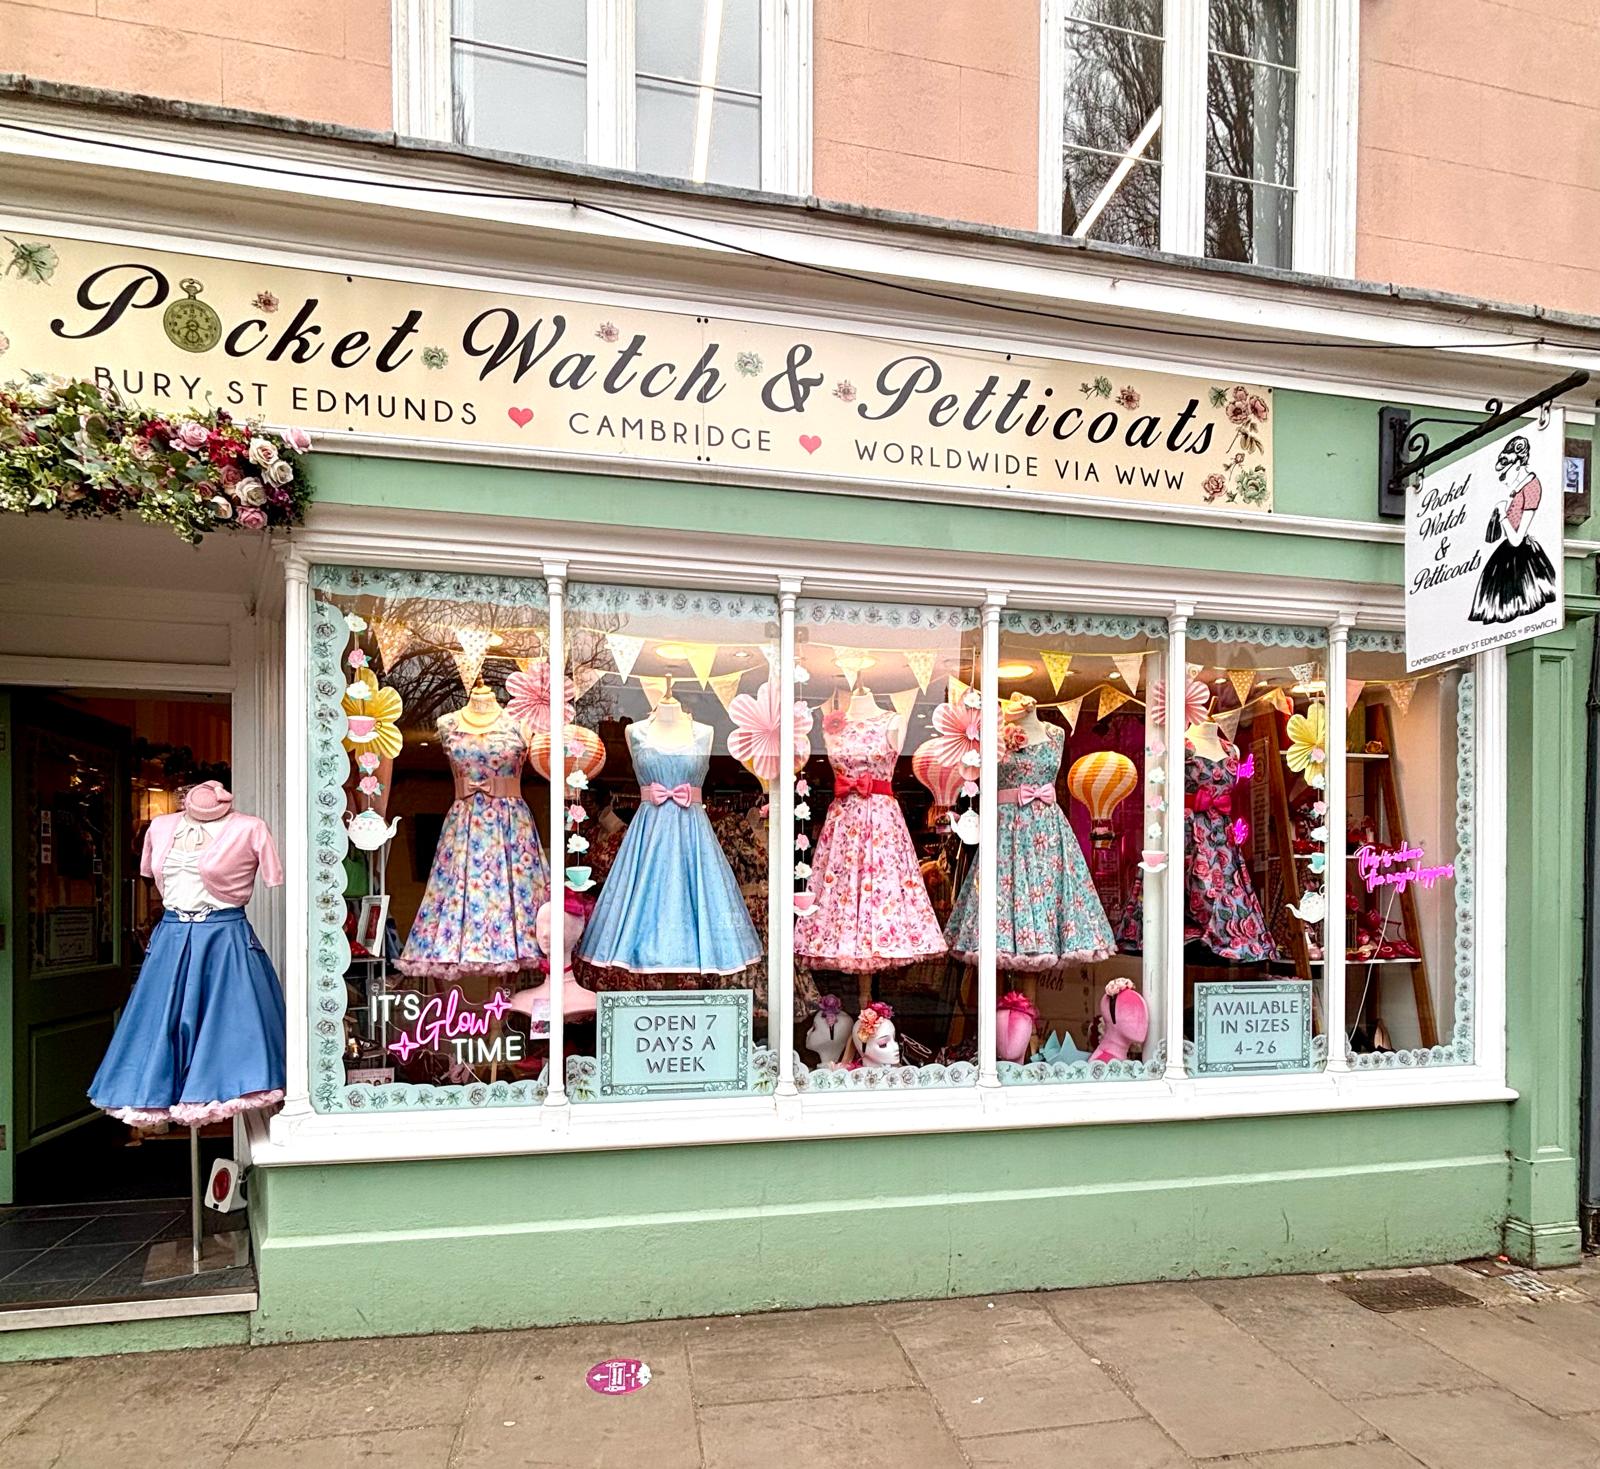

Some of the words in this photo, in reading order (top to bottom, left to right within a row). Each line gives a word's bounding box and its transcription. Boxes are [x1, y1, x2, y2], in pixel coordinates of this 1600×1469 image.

[94, 366, 200, 400] BURY
[227, 380, 267, 407] ST
[292, 386, 477, 425] EDMUNDS
[463, 308, 726, 403] Watch
[762, 344, 823, 412] &
[858, 355, 1214, 454] Petticoats
[569, 412, 771, 451] CAMBRIDGE
[855, 440, 1037, 476] WORLDWIDE
[1054, 459, 1100, 483] VIA
[1115, 464, 1184, 490] WWW
[1416, 473, 1472, 518] Pocket
[1419, 504, 1467, 542] Watch
[1435, 536, 1451, 562] &
[1409, 549, 1482, 596] Petticoats
[1411, 651, 1447, 667] CAMBRIDGE
[1452, 643, 1470, 656] BURY
[1471, 640, 1480, 649] ST
[1481, 629, 1517, 647] EDMUNDS
[1524, 618, 1558, 634] IPSWICH
[371, 993, 420, 1022] IT'S
[416, 989, 492, 1051] Glow
[634, 1015, 697, 1032] OPEN
[706, 1014, 718, 1030] 7
[1212, 1000, 1299, 1016] AVAILABLE
[1220, 1020, 1238, 1034] IN
[1245, 1018, 1290, 1033] SIZES
[452, 1035, 522, 1065] TIME
[636, 1036, 697, 1054] DAYS
[701, 1035, 716, 1051] A
[1234, 1040, 1277, 1055] 4-26
[647, 1057, 706, 1074] WEEK
